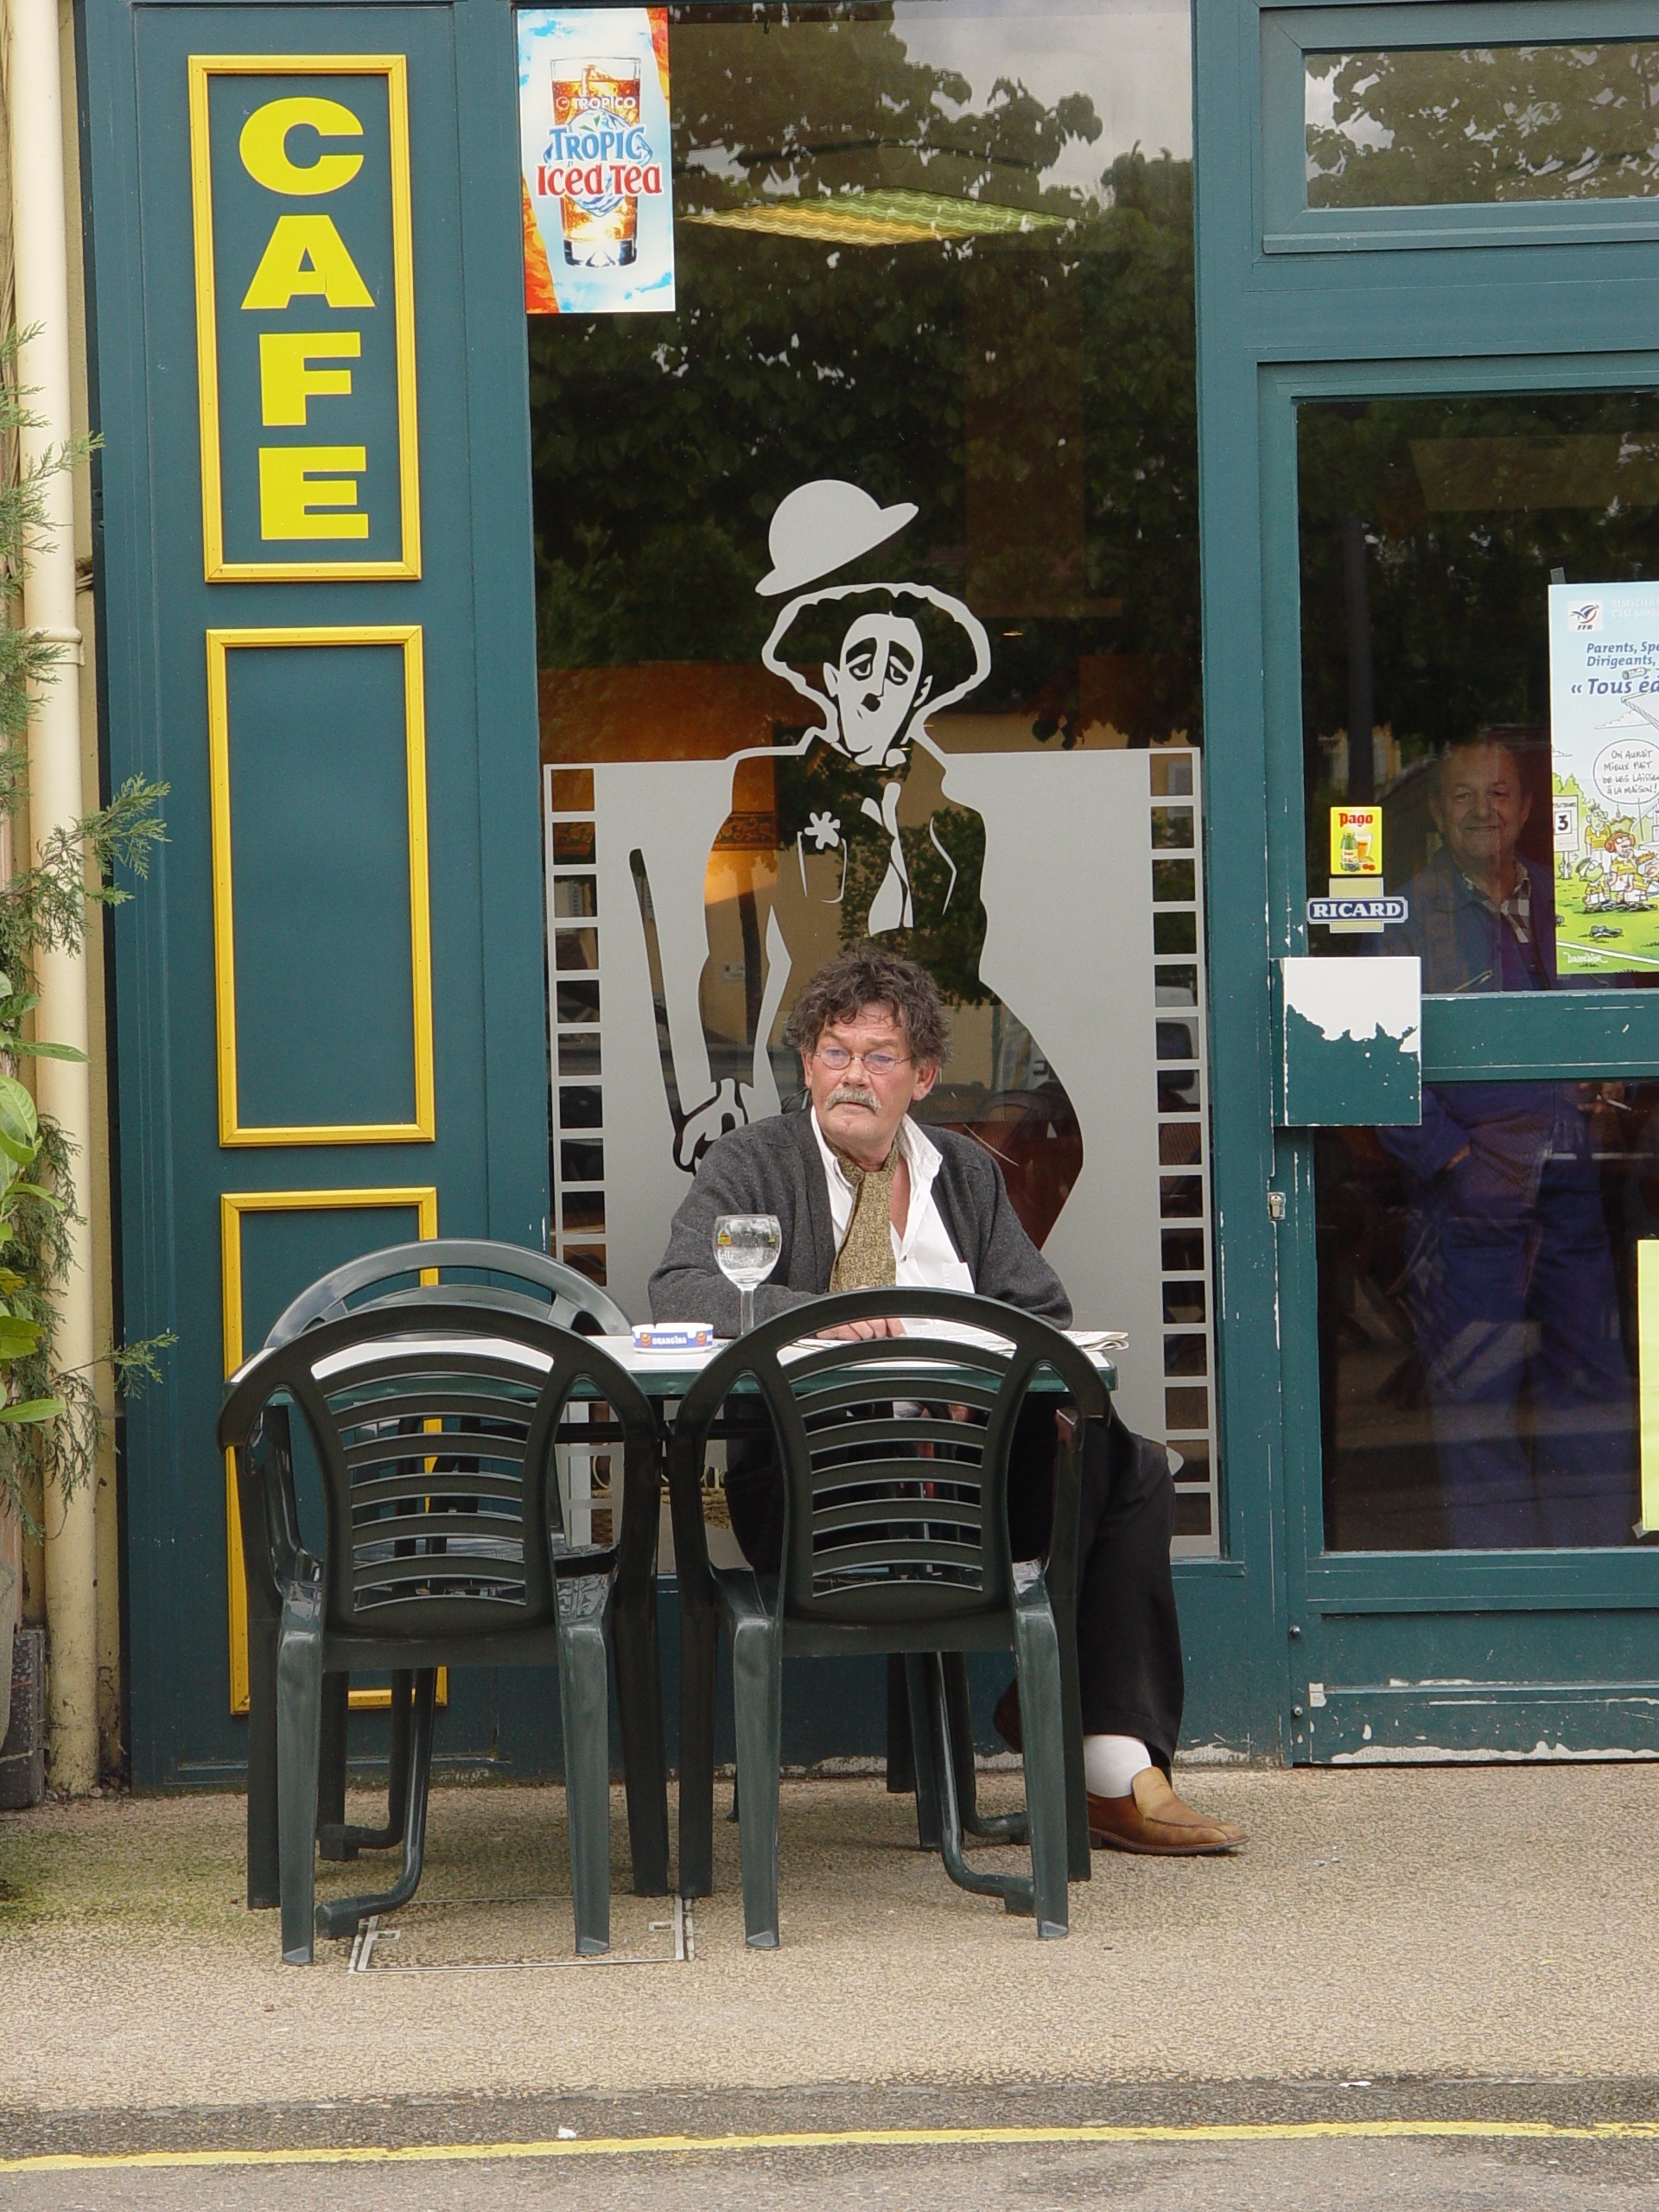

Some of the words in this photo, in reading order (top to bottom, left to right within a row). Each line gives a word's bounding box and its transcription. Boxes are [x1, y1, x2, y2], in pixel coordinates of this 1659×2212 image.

[575, 97, 637, 110] TROPICO
[537, 164, 604, 196] Iced
[609, 164, 662, 195] Tea
[239, 97, 376, 540] CAFE
[1586, 642, 1637, 655] Parents,
[1586, 654, 1656, 670] Dirigeants,
[1588, 678, 1632, 695] Tous
[1557, 814, 1569, 831] 3
[1313, 902, 1402, 918] RICARD
